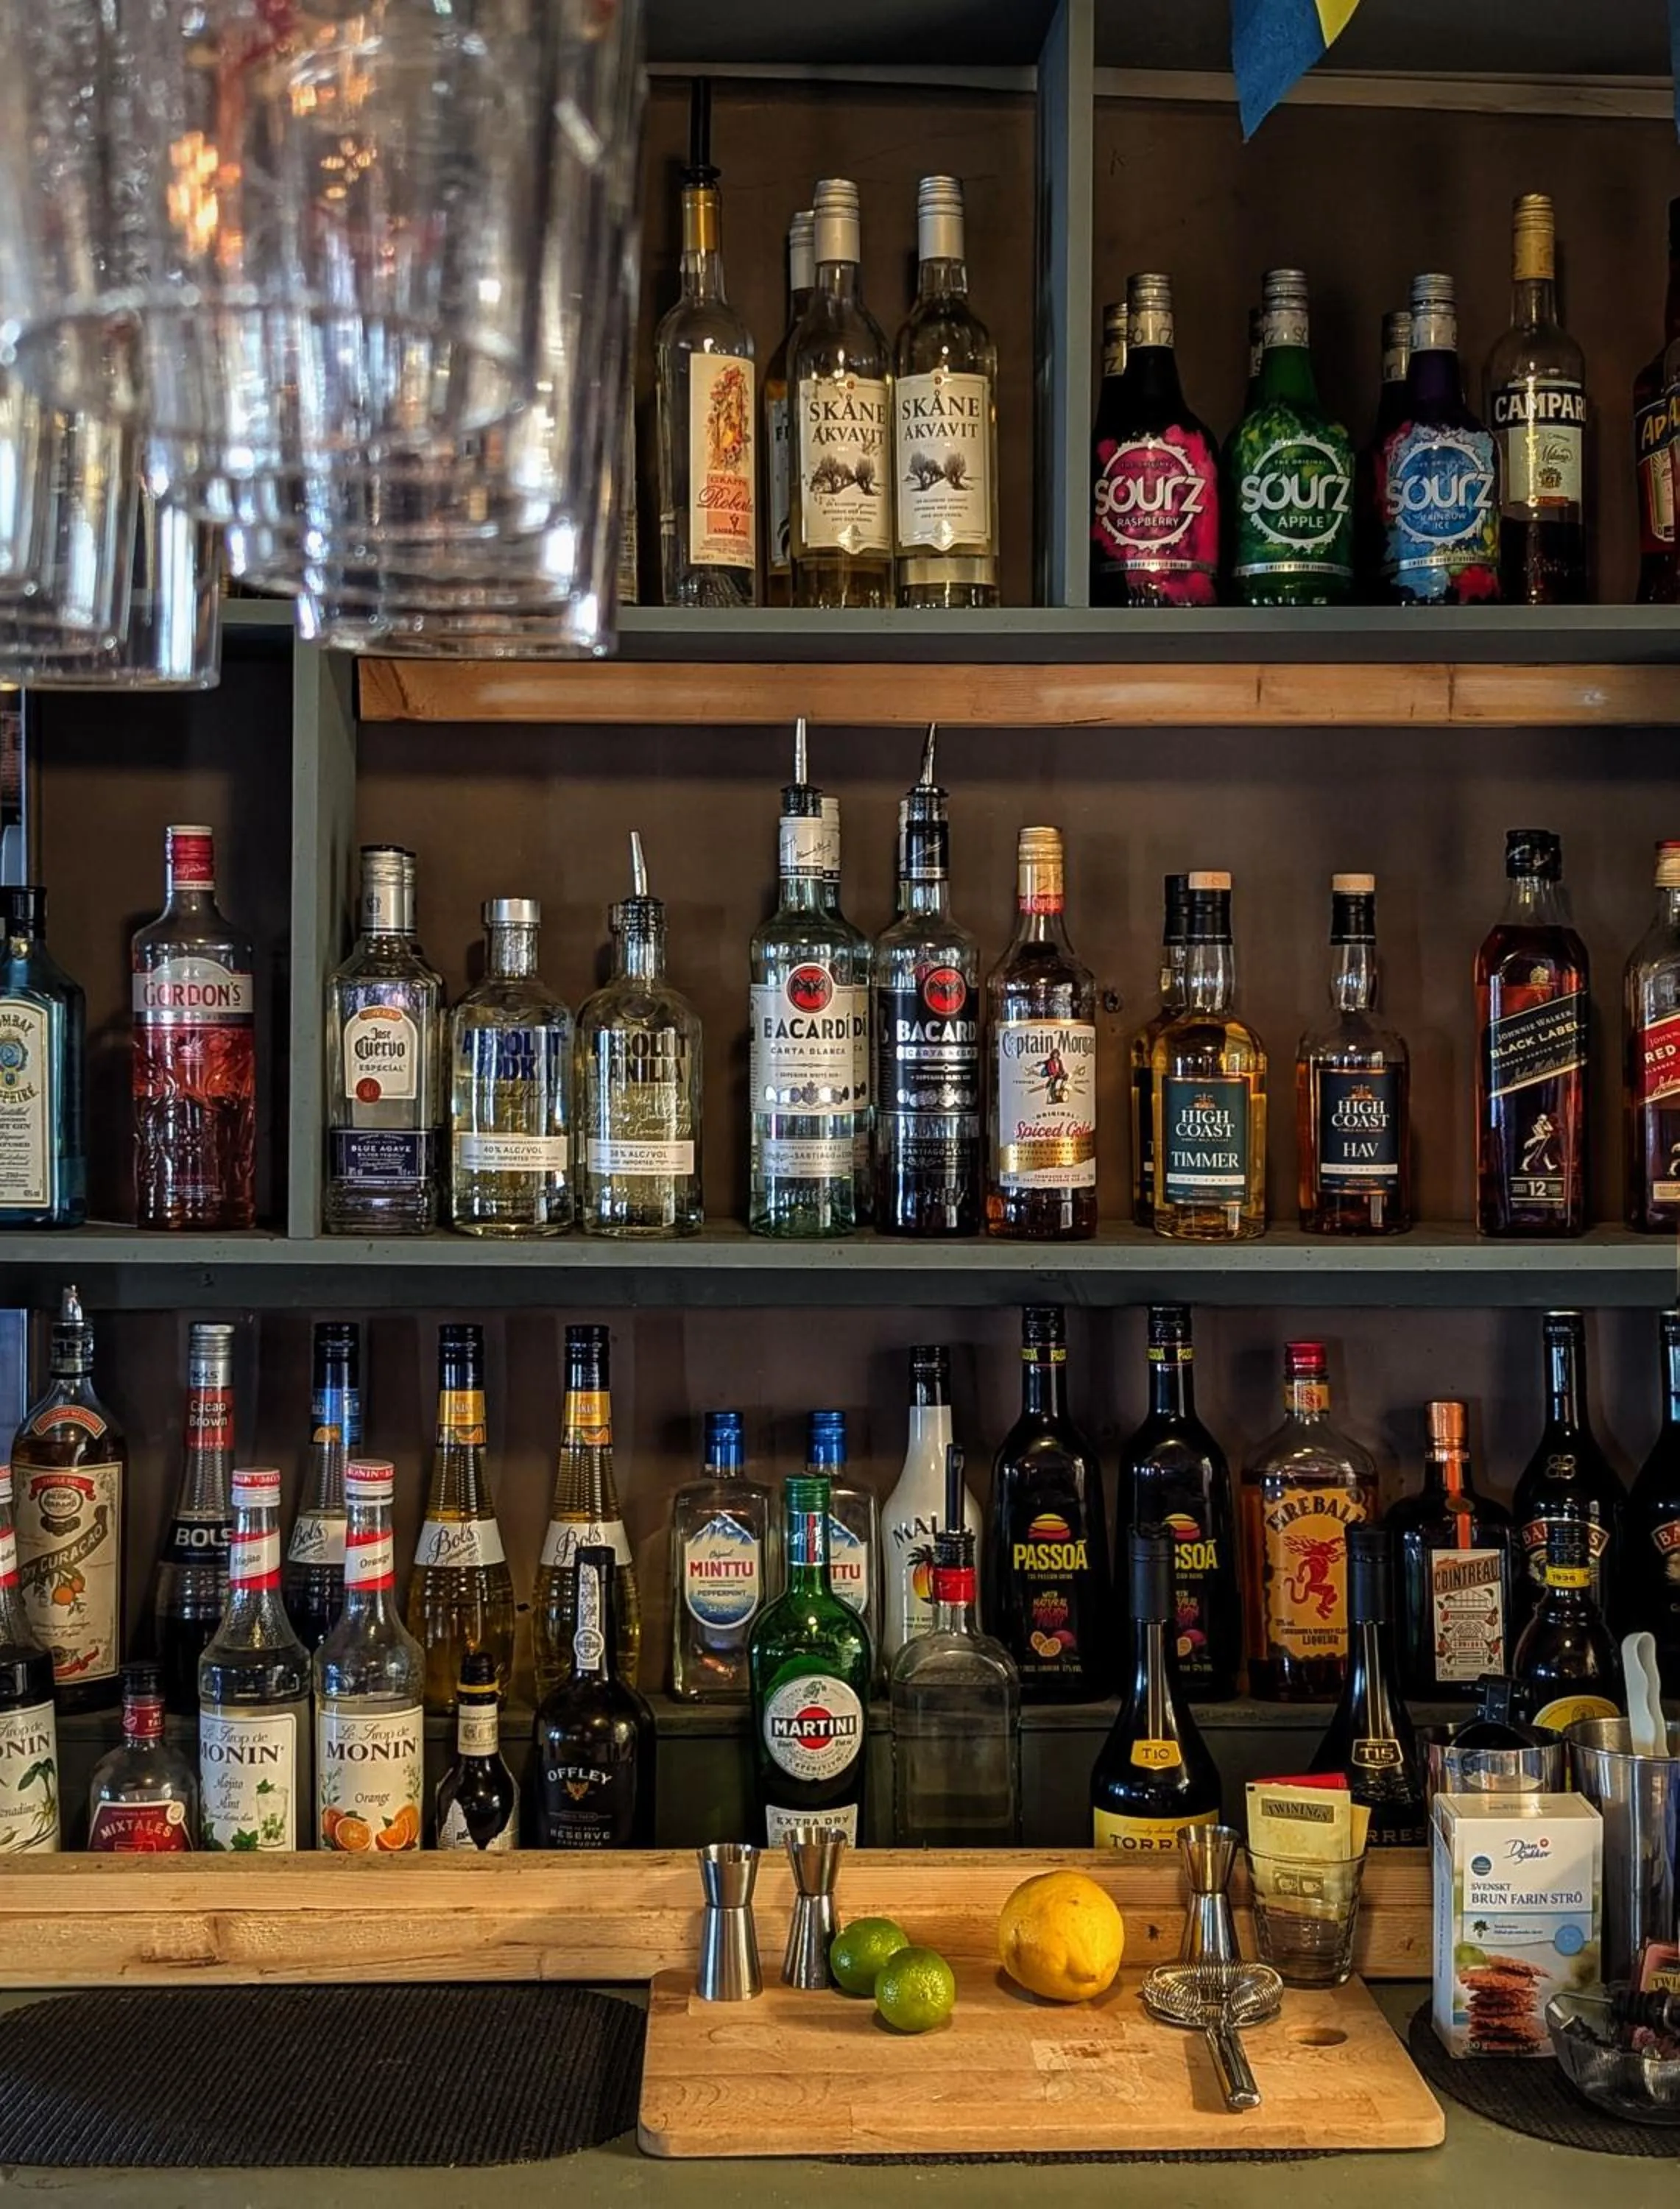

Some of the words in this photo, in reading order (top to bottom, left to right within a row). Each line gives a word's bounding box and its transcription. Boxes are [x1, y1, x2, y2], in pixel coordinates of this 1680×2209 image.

[810, 395, 884, 424] SKÅNE
[902, 390, 980, 420] SKÅNE
[904, 422, 978, 441] AKVAVIT
[1117, 516, 1179, 528] RASPBERRY
[1277, 516, 1324, 528] APPLE
[144, 982, 241, 1007] GORDON'S
[763, 1012, 850, 1039] BACARDÍ
[354, 1035, 406, 1060] Cuervo
[1490, 1036, 1536, 1059] BLACK
[1538, 1021, 1579, 1042] LABEL
[771, 1046, 805, 1054] CARTA
[809, 1047, 846, 1055] BLANCA
[1644, 1045, 1676, 1063] RED
[1338, 1100, 1385, 1114] HIGH
[1181, 1110, 1229, 1123] HIGH
[1331, 1114, 1390, 1127] COAST
[1015, 1121, 1064, 1140] Spiced
[1175, 1124, 1235, 1138] COAST
[504, 1146, 543, 1155] ALC/VOL
[628, 1151, 667, 1159] ALC/VOL
[1343, 1142, 1379, 1158] HAV
[1171, 1151, 1240, 1169] TIMMER
[1528, 1181, 1546, 1197] 12
[191, 1401, 226, 1412] Cacao
[188, 1414, 227, 1426] Brown
[174, 1528, 236, 1547] BOLS
[359, 1553, 391, 1569] Orange
[1012, 1538, 1088, 1571] PASSOÃ
[689, 1561, 755, 1577] MINTTU
[1436, 1555, 1499, 1591] COINTREAU
[359, 1723, 394, 1743] Sirop
[774, 1717, 854, 1736] MARTINI
[327, 1737, 417, 1761] MONIN
[1359, 1747, 1394, 1760] T15
[547, 1767, 613, 1785] OFFLEY
[354, 1792, 391, 1806] Orange
[1267, 1802, 1330, 1822] TWININGS
[99, 1819, 174, 1839] MIXTALES
[777, 1817, 819, 1826] EXTRA
[825, 1816, 850, 1825] DRY
[1471, 1883, 1512, 1891] SVENSKT
[1472, 1892, 1507, 1904] BRUN
[1511, 1892, 1547, 1904] FARIN
[1550, 1890, 1583, 1904] STRÖ
